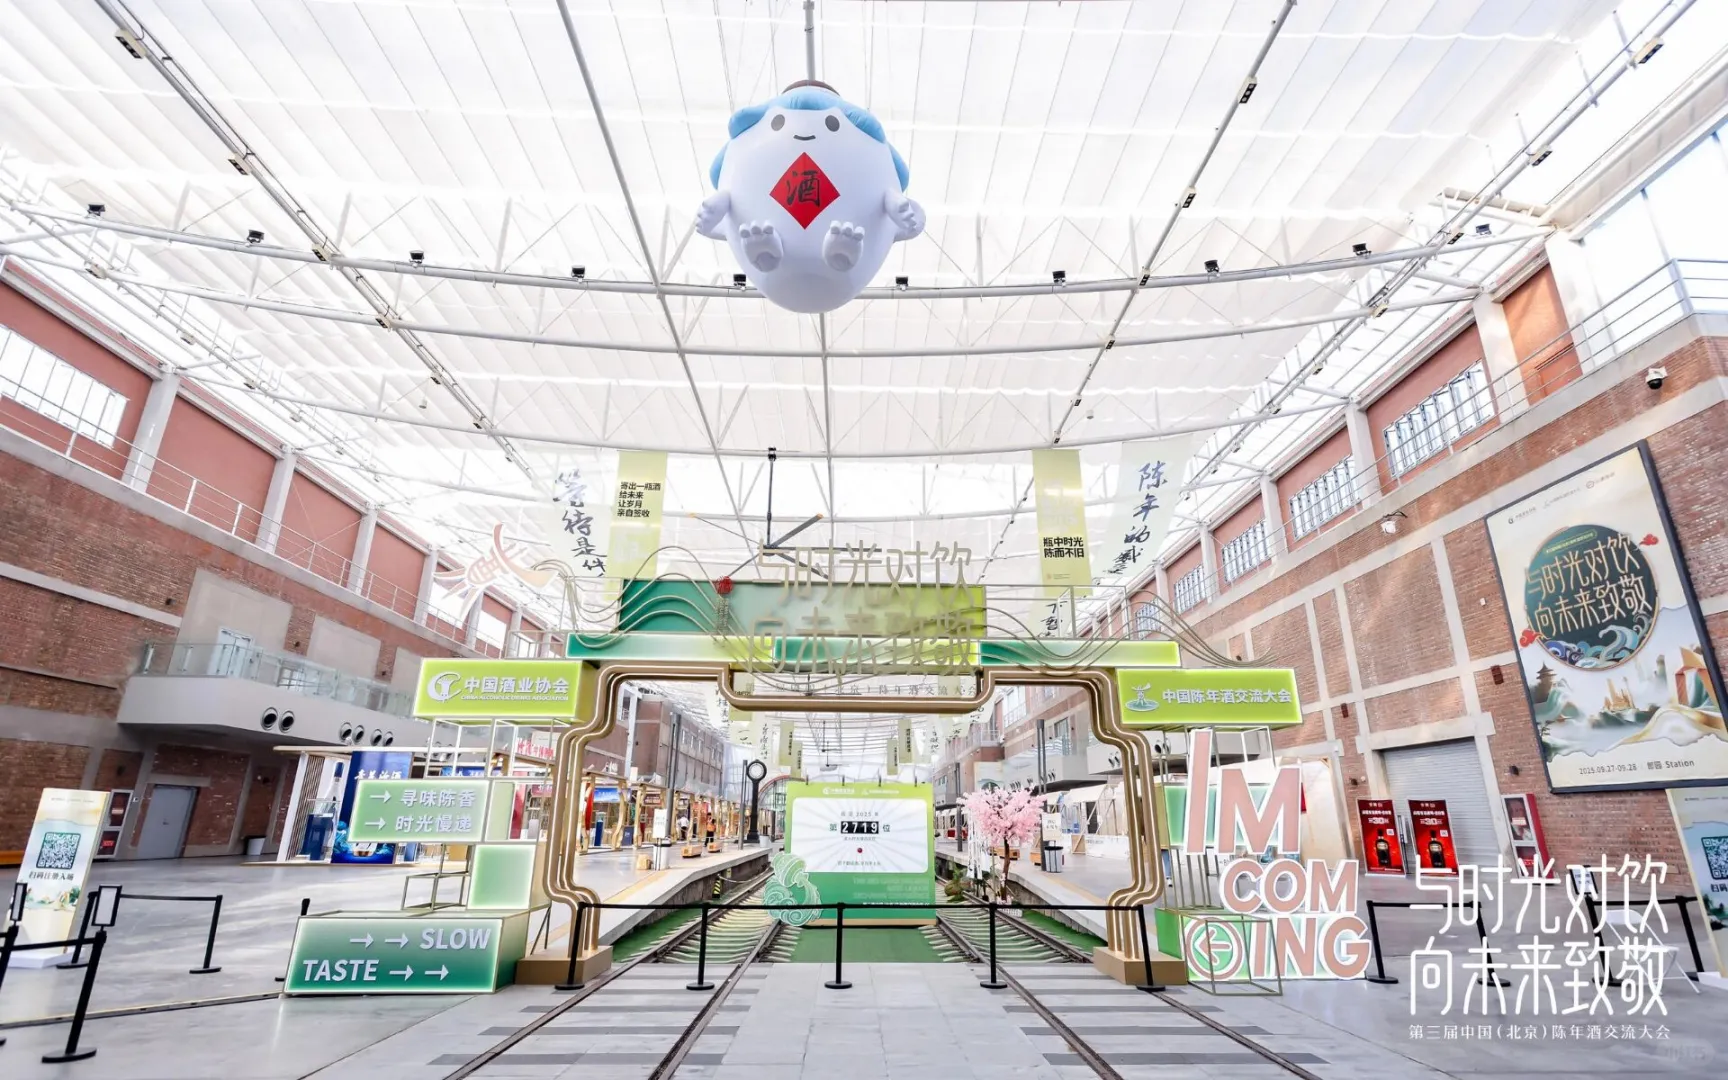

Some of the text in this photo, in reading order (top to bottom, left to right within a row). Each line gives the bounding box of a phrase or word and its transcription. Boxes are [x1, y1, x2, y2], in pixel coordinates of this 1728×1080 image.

[786, 170, 820, 207] 酒
[618, 500, 643, 508] 让岁月
[619, 491, 644, 499] 给未来
[617, 509, 650, 518] 亲自签收
[1043, 536, 1084, 547] 瓶中时光
[1044, 547, 1085, 559] 陈而不旧
[752, 538, 974, 606] 与时光对饮
[1525, 533, 1640, 599] 与时光对饮
[1534, 573, 1652, 637] 向未来致敬
[464, 676, 569, 694] 中国酒业协会
[1162, 688, 1291, 703] 中国陈年酒交流大会
[1665, 759, 1695, 769] Station
[400, 789, 476, 808] 寻味陈香
[395, 814, 473, 833] 时光慢递
[842, 822, 878, 833] 2719
[420, 928, 491, 950] SLOW
[303, 959, 379, 982] TASTE
